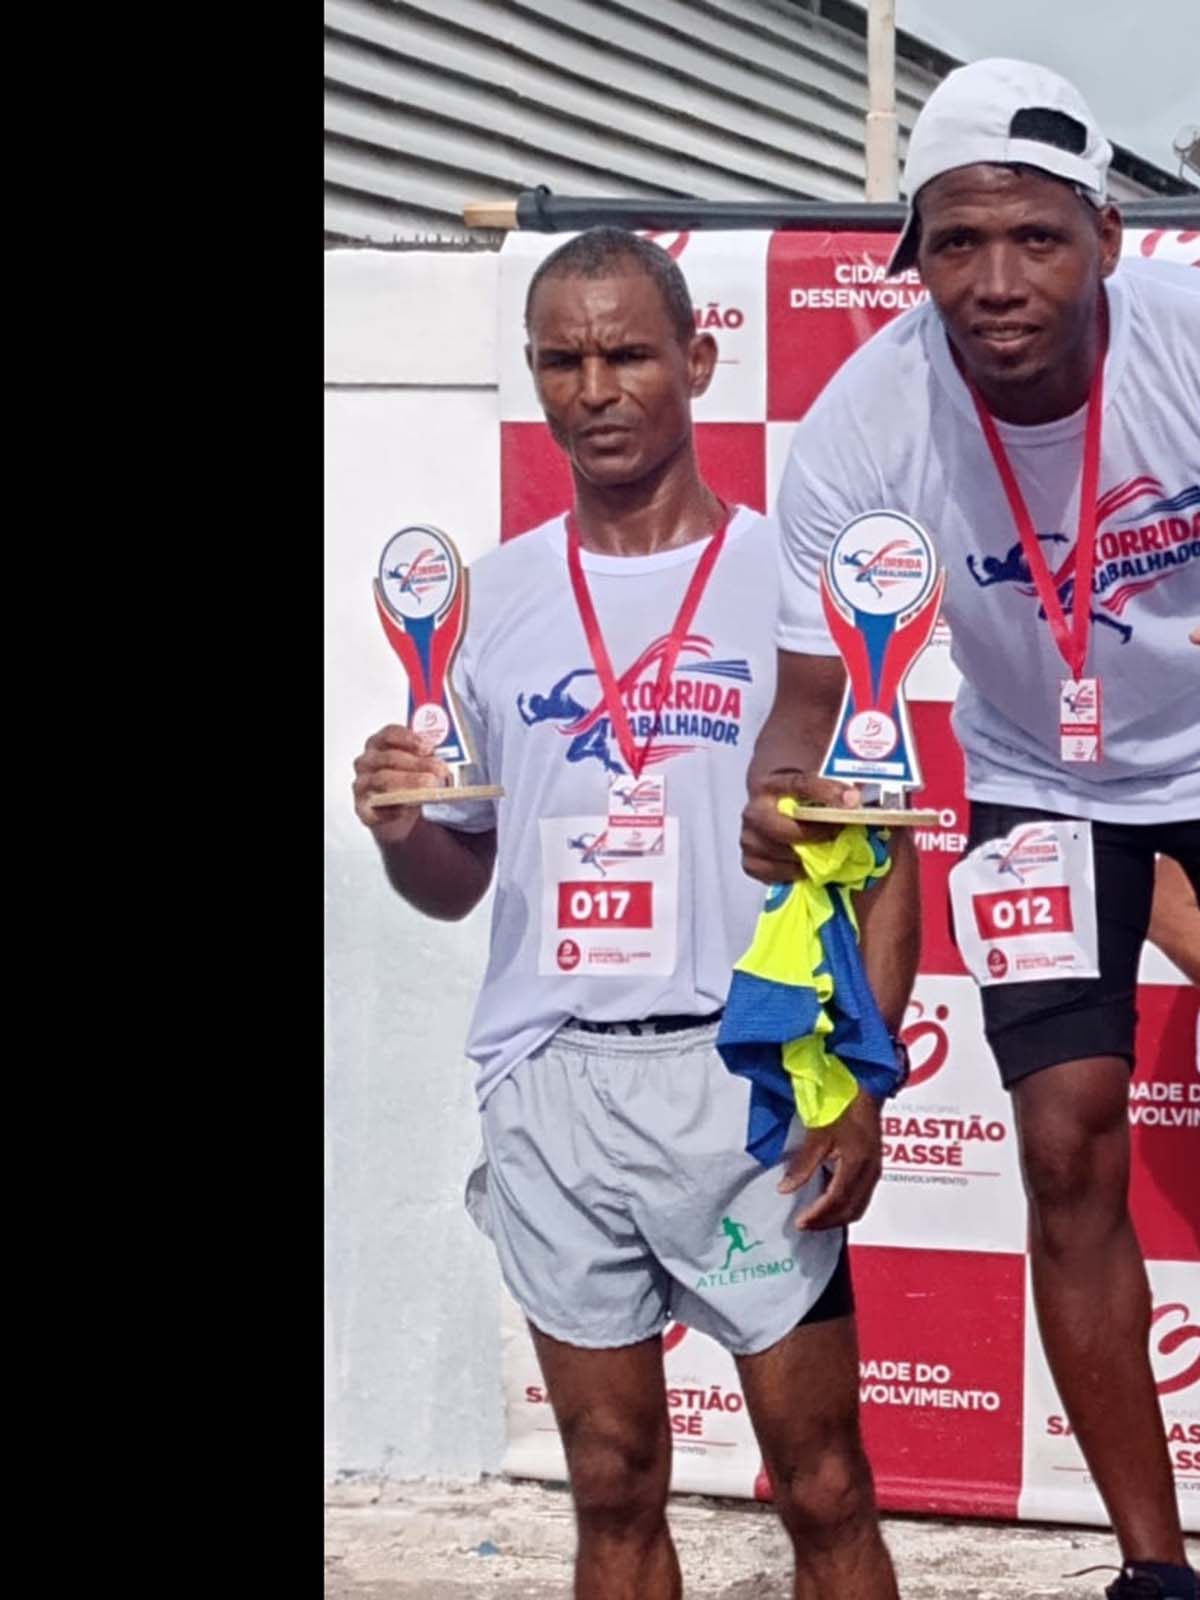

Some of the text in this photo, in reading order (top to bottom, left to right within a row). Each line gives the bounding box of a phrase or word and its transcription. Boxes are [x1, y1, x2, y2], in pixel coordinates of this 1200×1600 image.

[570, 890, 630, 920] 017
[992, 896, 1053, 929] 012
[882, 1115, 1006, 1142] BASTIÃO
[696, 1258, 795, 1289] ATLETISMO
[915, 1363, 951, 1383] DO
